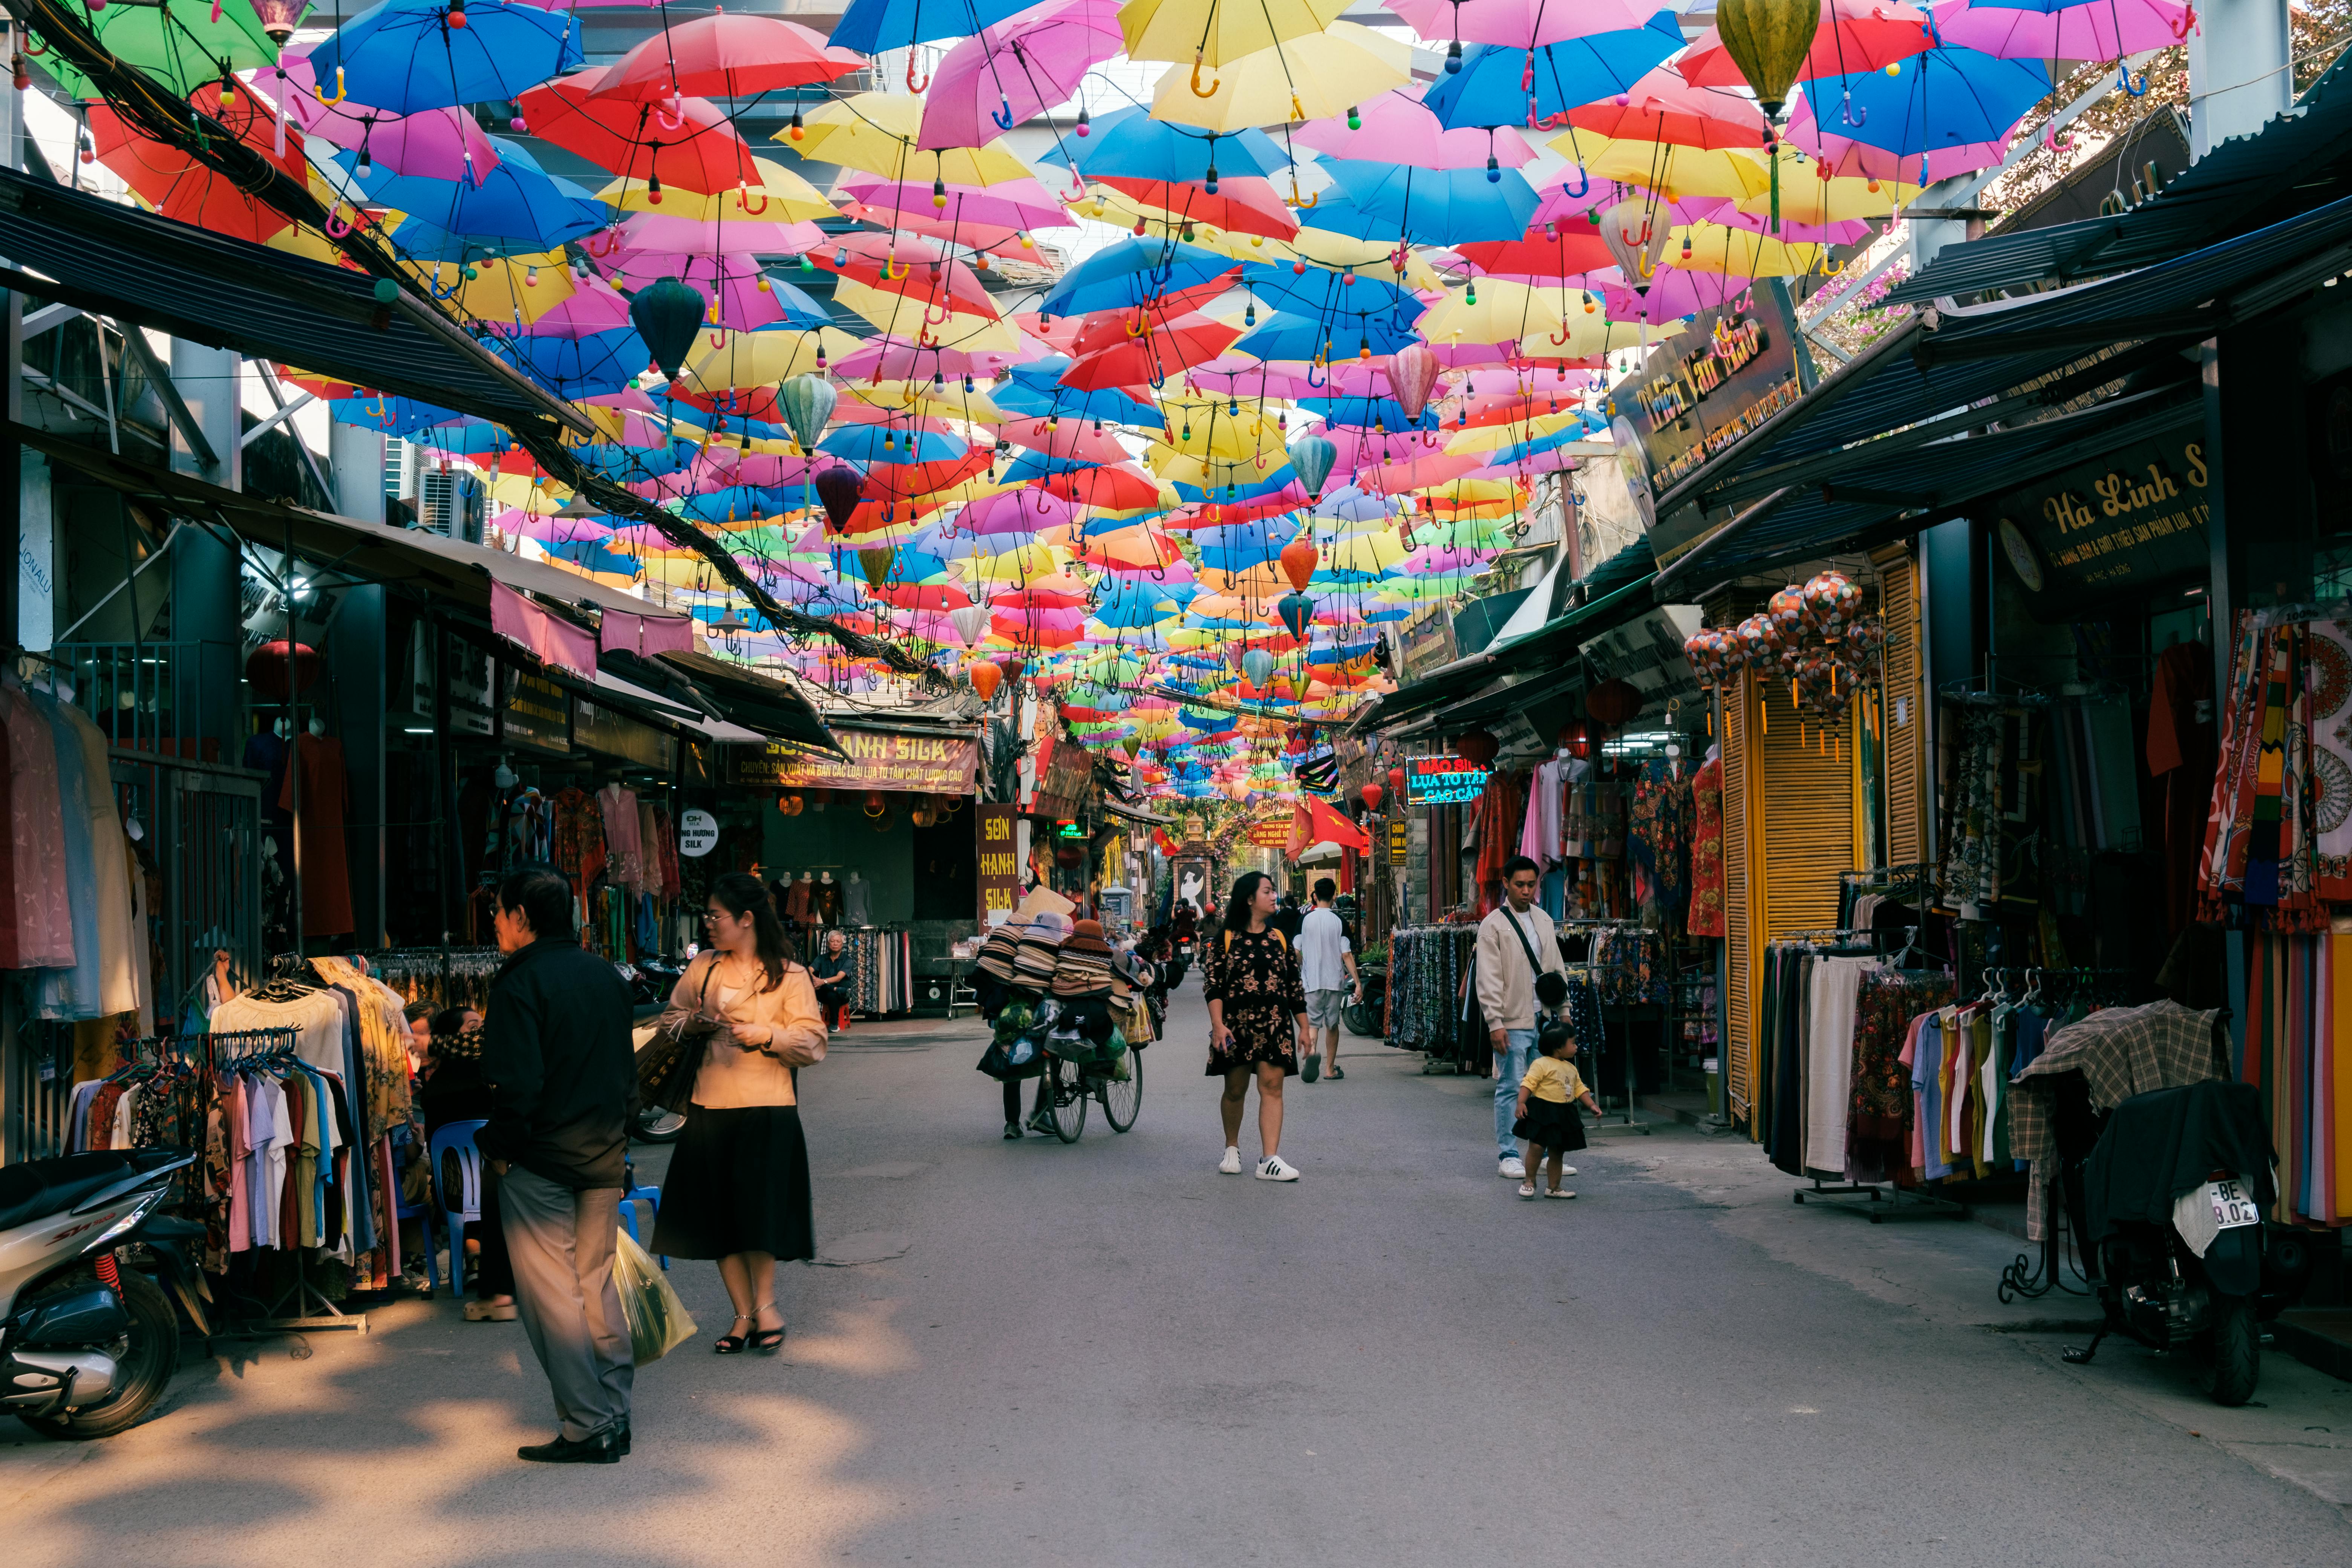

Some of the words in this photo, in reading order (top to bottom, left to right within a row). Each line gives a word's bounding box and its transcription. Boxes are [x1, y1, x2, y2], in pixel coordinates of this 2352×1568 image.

[2043, 492, 2096, 534] Hà
[2095, 464, 2179, 516] Linh
[2091, 541, 2101, 556] &
[2111, 527, 2135, 549] THIỆU
[2133, 519, 2153, 542] SẢN
[2148, 509, 2175, 537] PHẨM
[2171, 511, 2192, 533] LỤA
[2286, 609, 2319, 621] 100%
[896, 738, 947, 761] SILK
[741, 760, 769, 773] CHUYÊN:
[772, 759, 786, 775] SẢN
[787, 760, 805, 776] XUẤT
[806, 762, 815, 776] VÀ
[817, 763, 831, 777] BÁN
[847, 765, 863, 780] LOẠI
[864, 767, 877, 780] LỤA
[879, 767, 888, 779] TƠ
[889, 763, 904, 779] TẰM
[906, 765, 924, 781] CHẤT
[925, 769, 947, 784] LƯỢNG
[949, 770, 963, 782] CAO
[1412, 775, 1440, 789] LỤA
[1425, 789, 1453, 802] CAO
[986, 815, 1010, 840] SƠN
[1268, 829, 1282, 838] NGHỀ
[980, 853, 1015, 880] HẠNH
[986, 887, 1013, 910] SILK
